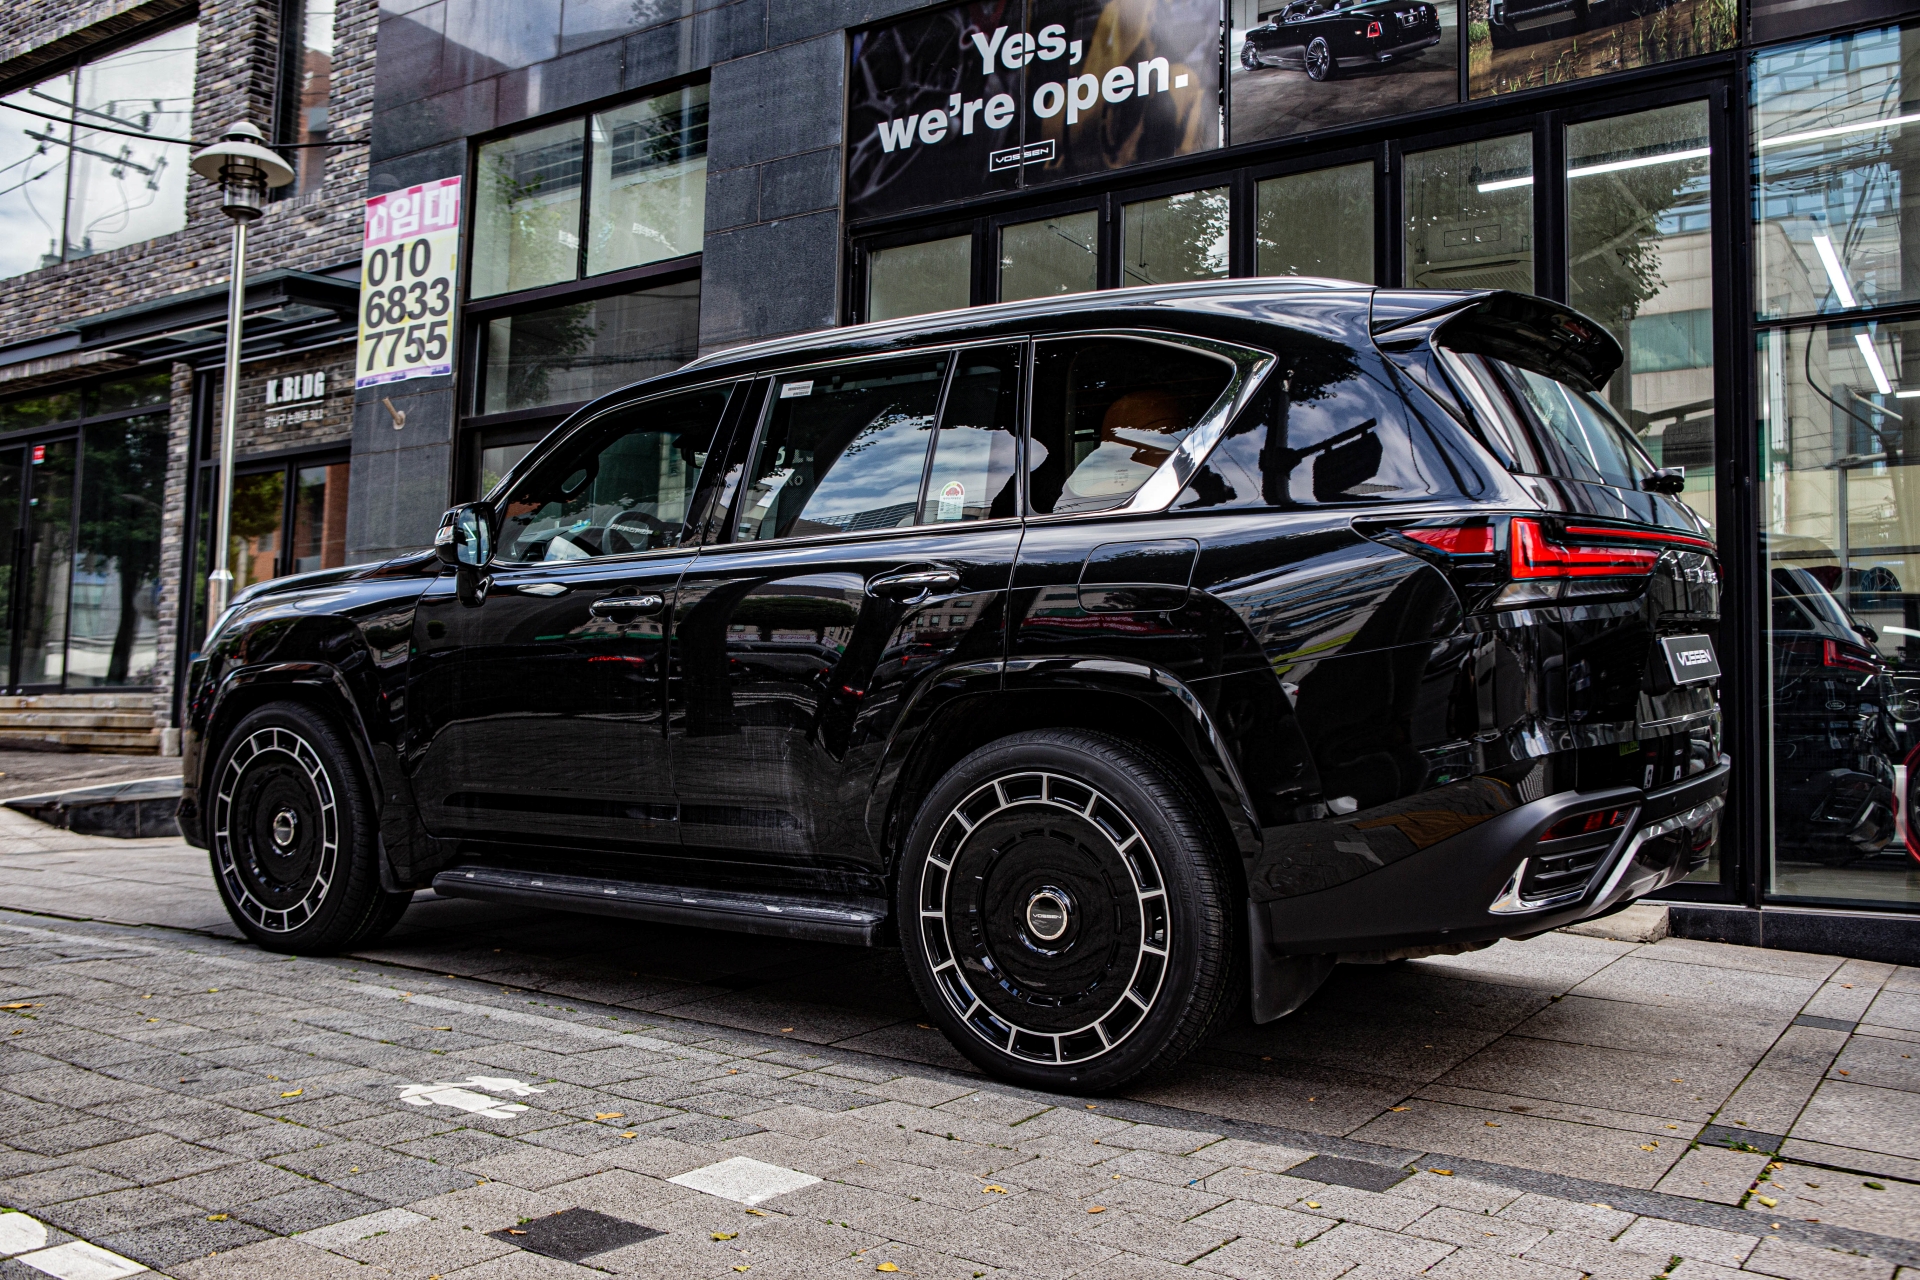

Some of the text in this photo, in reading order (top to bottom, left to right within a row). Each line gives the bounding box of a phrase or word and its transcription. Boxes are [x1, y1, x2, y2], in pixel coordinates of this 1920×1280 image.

[971, 23, 1083, 75] Yes,
[877, 56, 1189, 153] we're open.
[995, 147, 1049, 163] VOSSEN
[389, 184, 456, 237] 임대
[367, 238, 431, 287] 010
[365, 277, 450, 329] 6833
[364, 319, 449, 372] 7755
[265, 371, 325, 405] K.BLDG
[1676, 649, 1712, 666] VOSSEN
